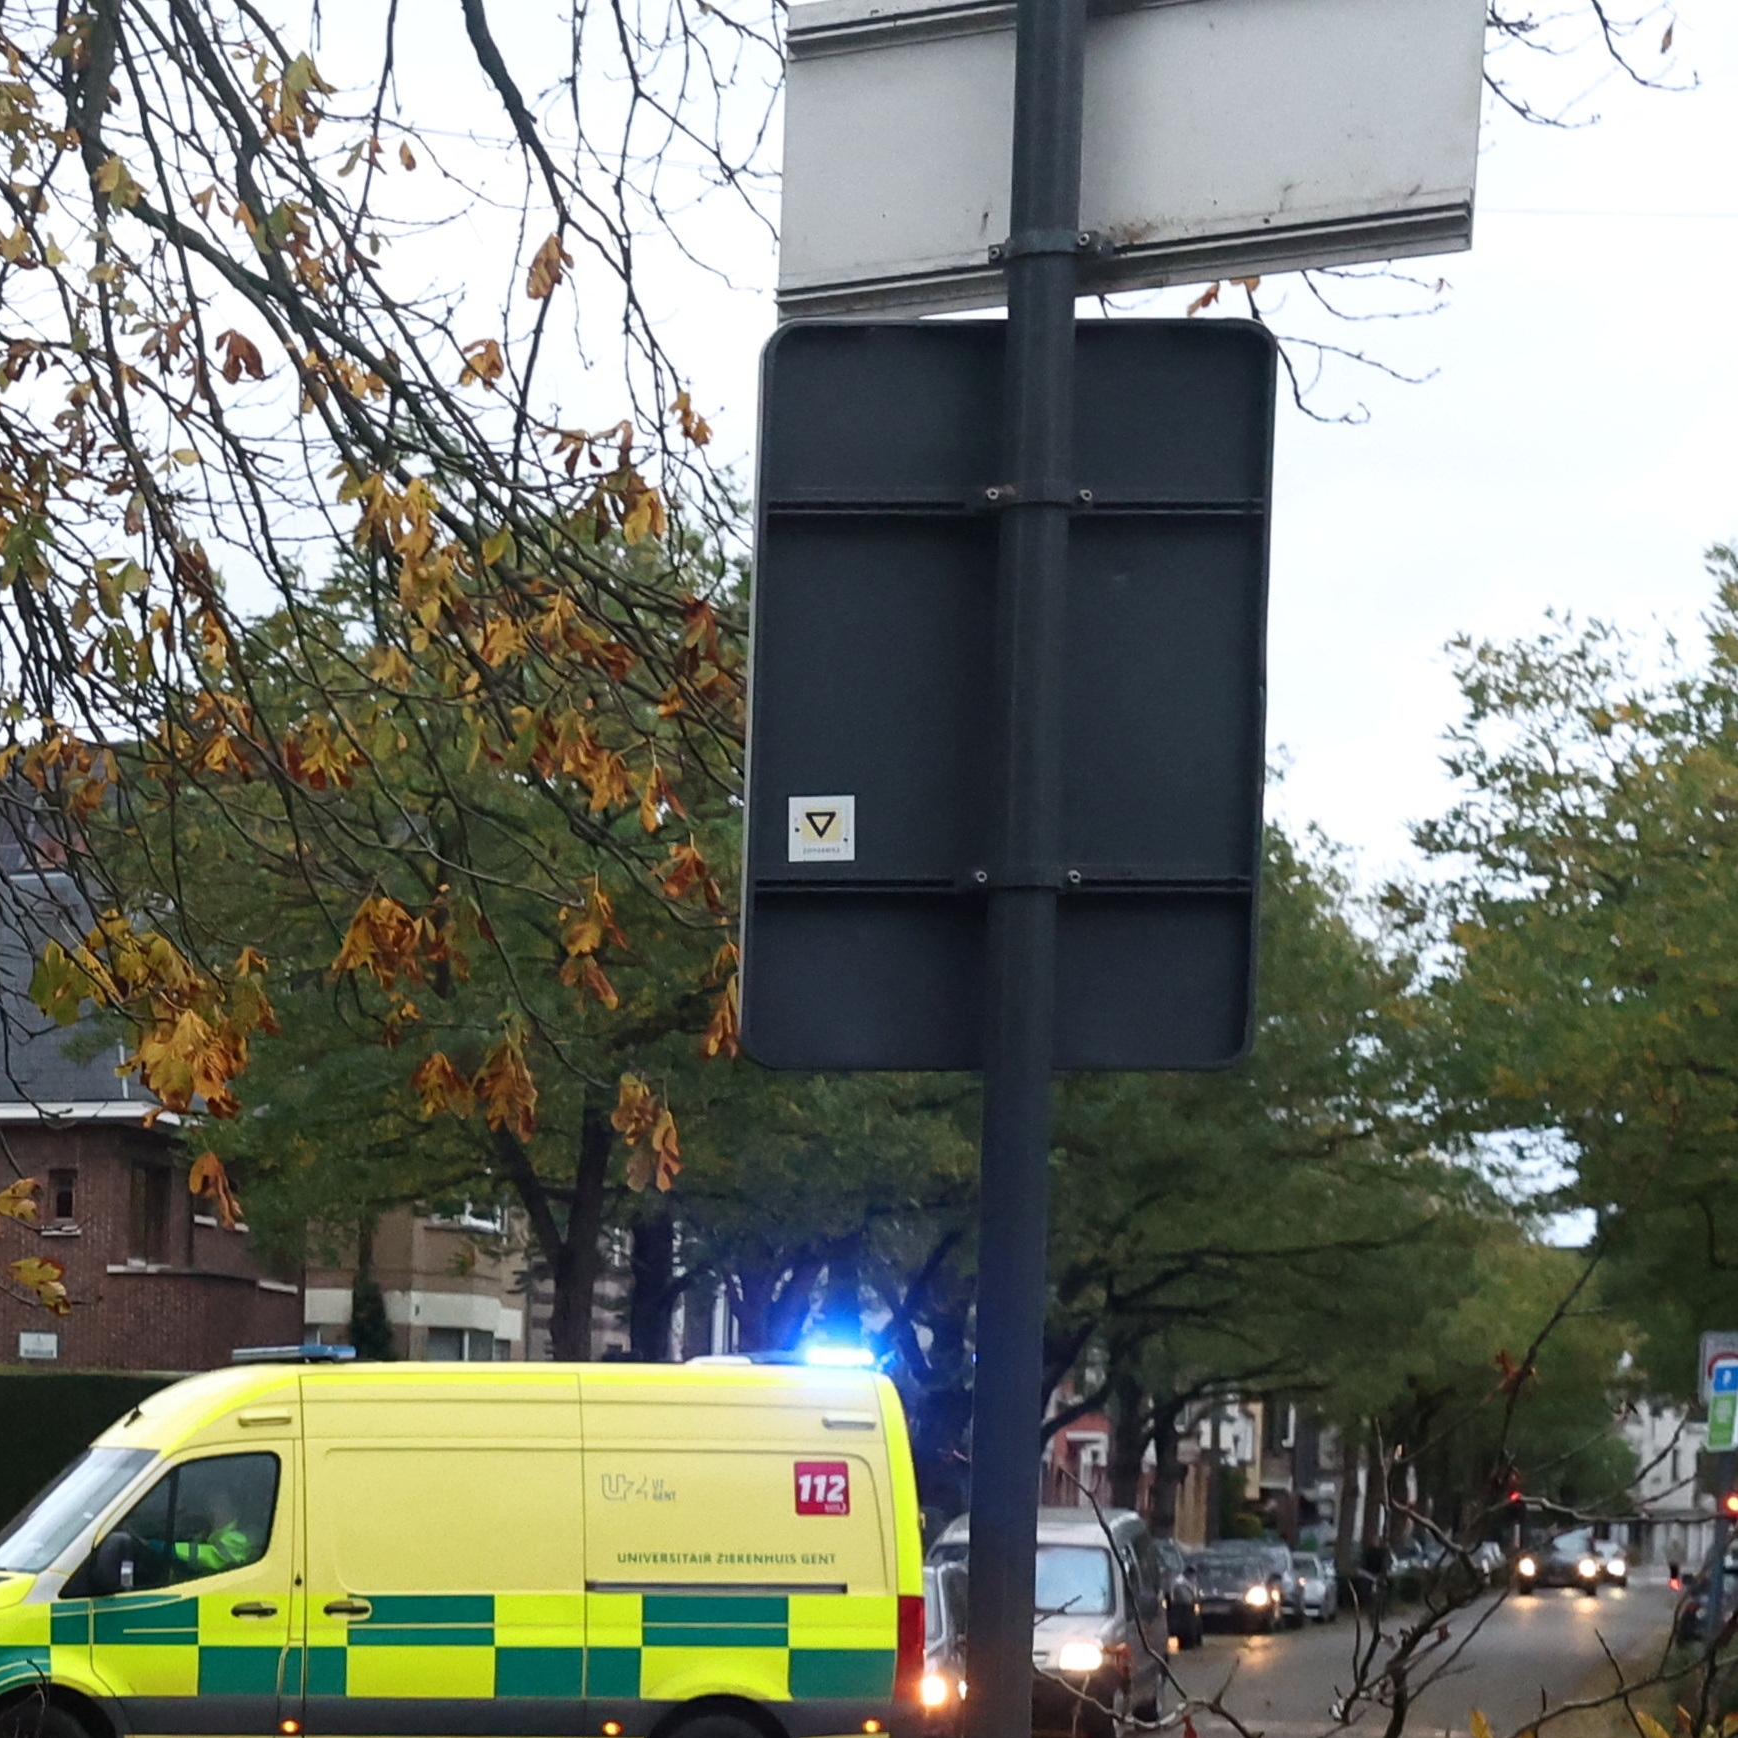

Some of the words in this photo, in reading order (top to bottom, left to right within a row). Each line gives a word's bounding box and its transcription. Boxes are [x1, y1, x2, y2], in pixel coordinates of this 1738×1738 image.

[798, 1473, 846, 1503] 112
[617, 1552, 711, 1564] UNIVERSITAIR
[716, 1552, 797, 1565] ZIEKENHUIS
[800, 1552, 836, 1565] GENT
